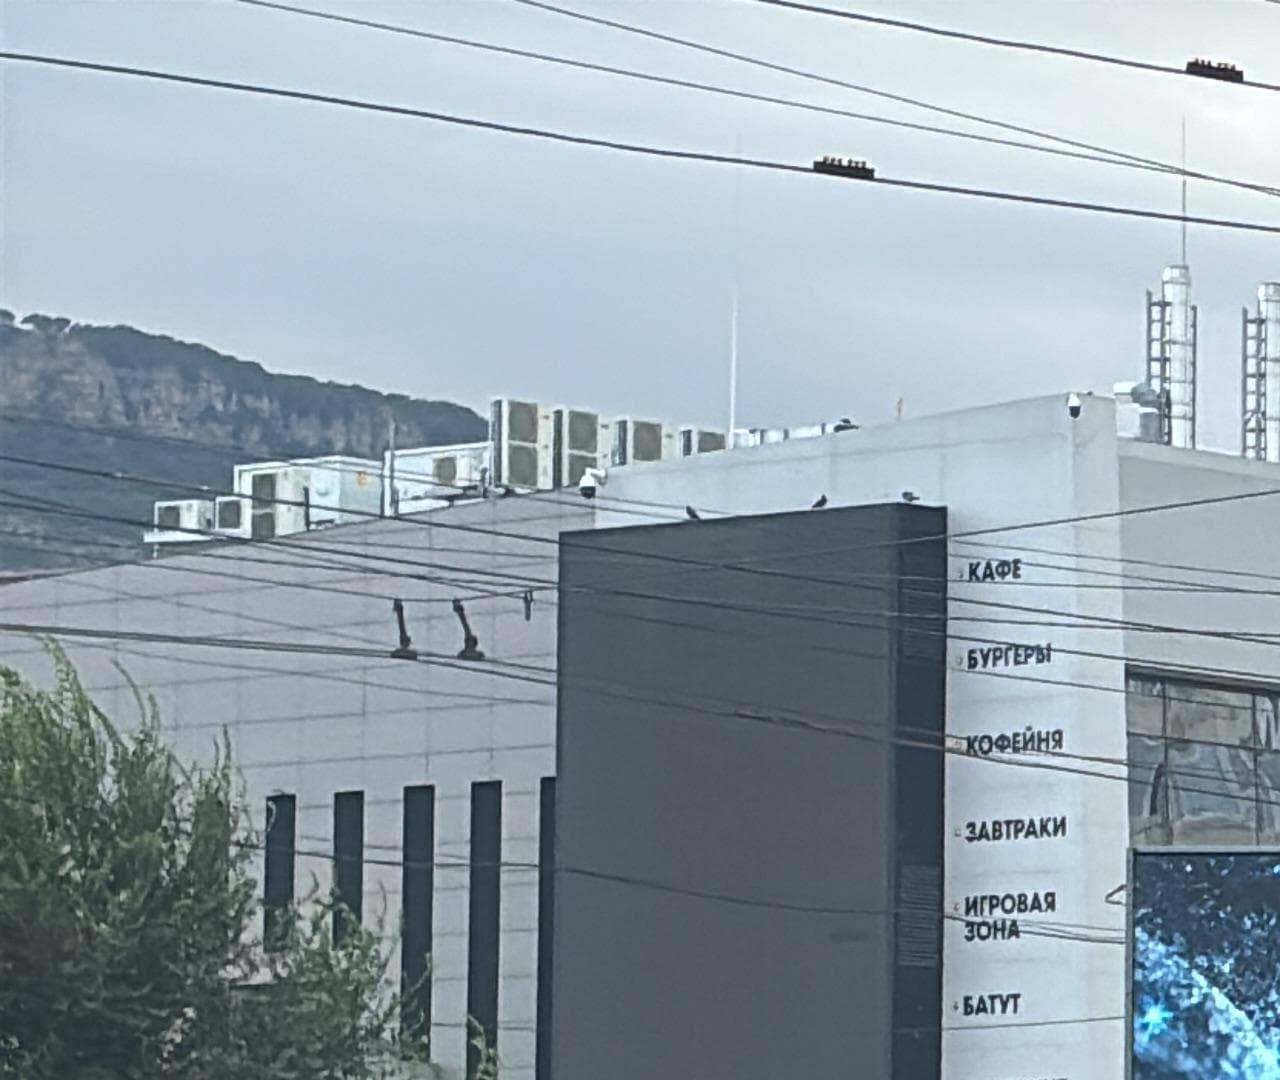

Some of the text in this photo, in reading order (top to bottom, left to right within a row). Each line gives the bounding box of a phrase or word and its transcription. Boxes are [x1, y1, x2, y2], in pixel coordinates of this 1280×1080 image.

[968, 558, 1022, 581] КАФЕ
[967, 643, 1052, 670] БУРГЕРЫ
[966, 726, 1063, 755] КОФЕЙНЯ
[965, 815, 1067, 842] ЗАВТРАКИ
[964, 892, 1056, 917] ИГРОВАЯ
[964, 919, 1020, 942] ЗОНА
[963, 993, 1021, 1016] БАТУТ
